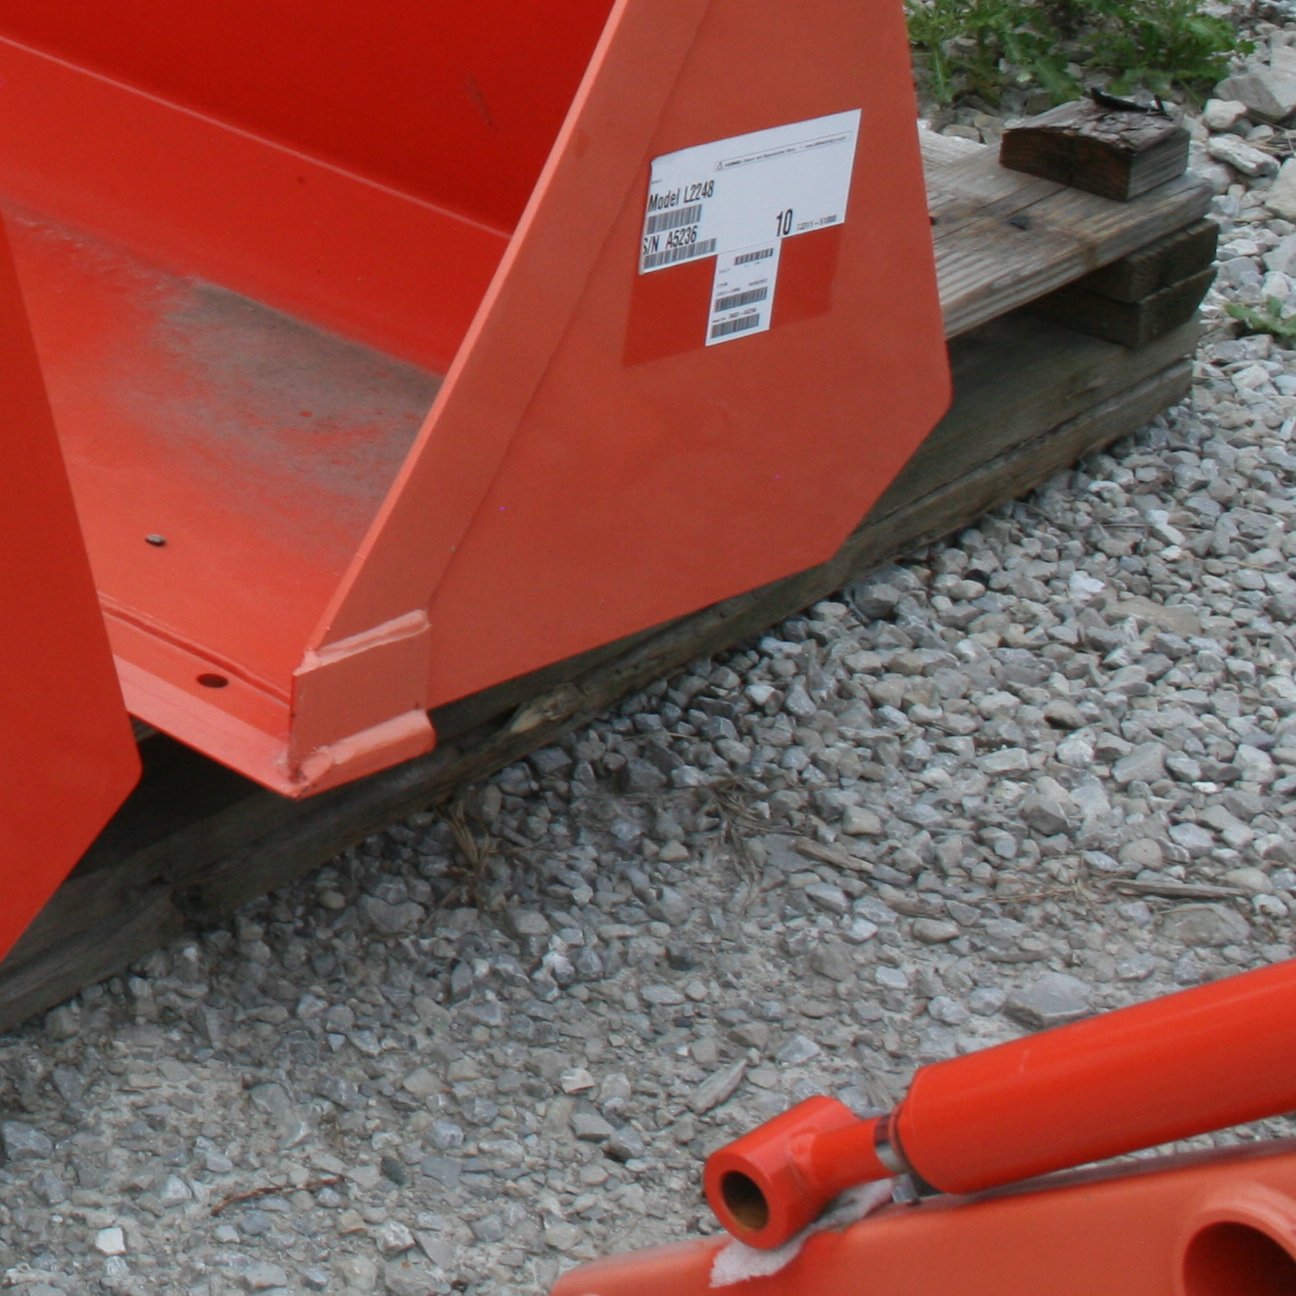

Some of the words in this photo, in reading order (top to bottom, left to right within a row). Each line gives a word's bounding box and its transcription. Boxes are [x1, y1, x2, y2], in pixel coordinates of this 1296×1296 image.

[648, 188, 680, 212] Model
[683, 179, 716, 205] L2248
[775, 208, 794, 237] 10
[642, 233, 659, 255] S/N
[665, 224, 698, 250] A5236
